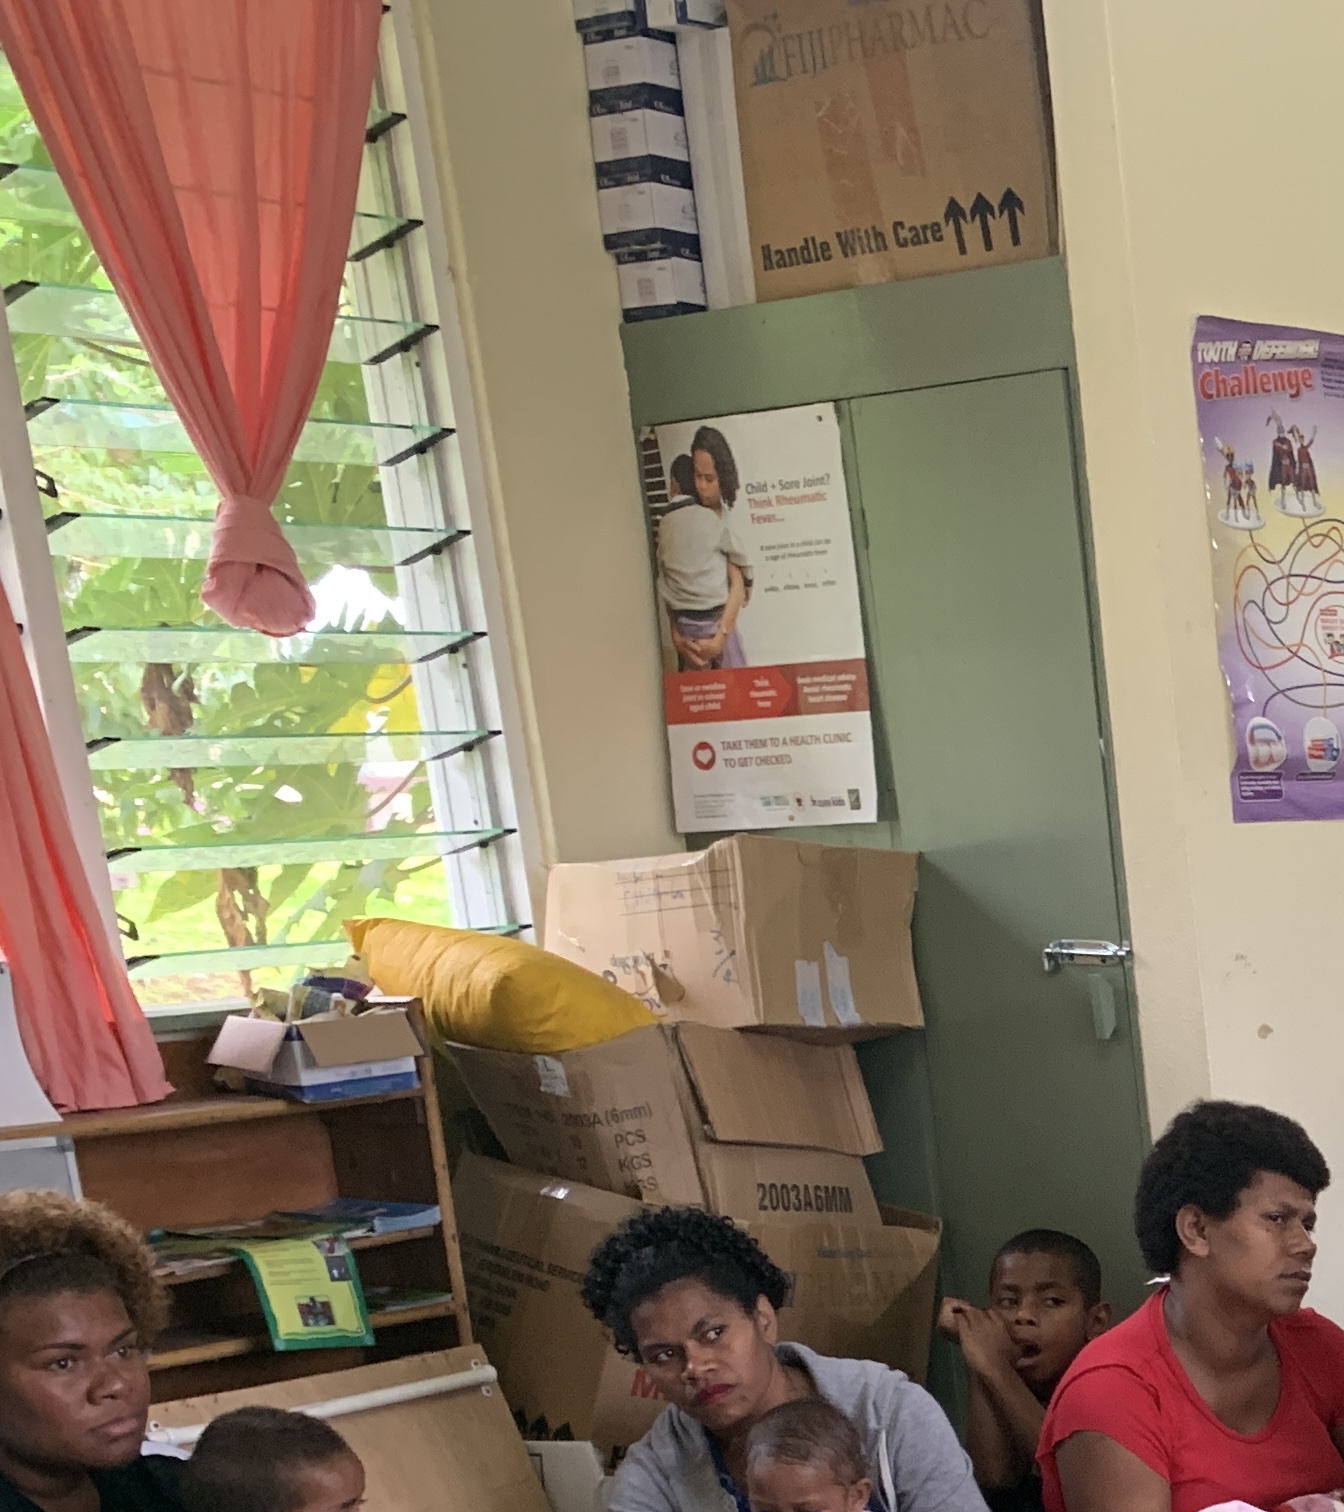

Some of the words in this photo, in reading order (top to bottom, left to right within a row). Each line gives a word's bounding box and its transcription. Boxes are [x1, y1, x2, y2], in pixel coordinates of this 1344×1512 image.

[762, 237, 832, 272] Handle
[836, 225, 888, 259] With
[892, 220, 943, 248] Care
[1197, 340, 1237, 363] TOOTH
[1200, 366, 1313, 400] Challenge
[746, 482, 768, 495] Child
[778, 479, 800, 491] Sore
[803, 473, 830, 488] Joint?
[747, 497, 773, 508] Think
[775, 492, 827, 506] Rheumatic
[721, 741, 743, 751] TAKE
[745, 739, 768, 749] THEM
[789, 734, 821, 745] HEALTH
[823, 733, 852, 742] CLINIC
[724, 758, 736, 768] TO
[738, 757, 753, 767] GET
[755, 755, 792, 766] CHECKED
[605, 1103, 653, 1127] (6mm)
[614, 1129, 646, 1148] PCS
[618, 1153, 652, 1172] KGS
[757, 1183, 852, 1213] 2003A6MM
